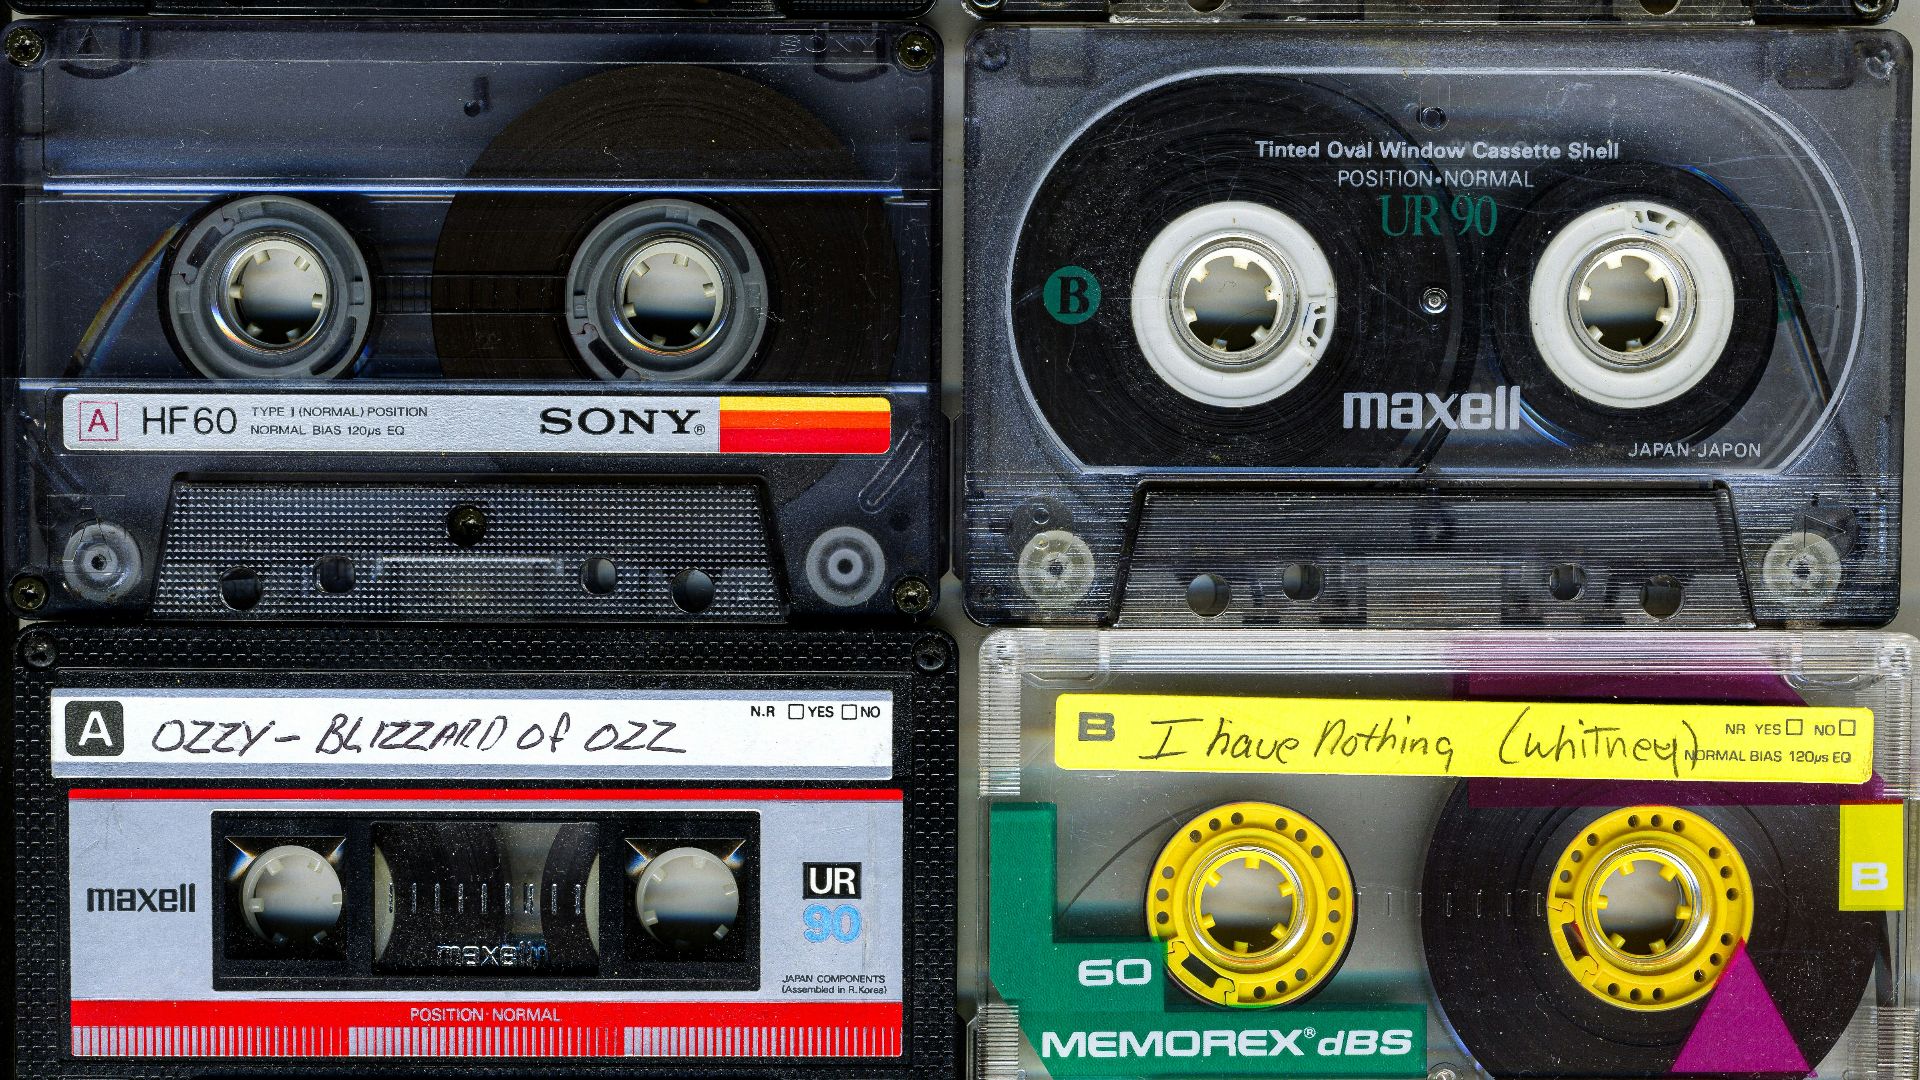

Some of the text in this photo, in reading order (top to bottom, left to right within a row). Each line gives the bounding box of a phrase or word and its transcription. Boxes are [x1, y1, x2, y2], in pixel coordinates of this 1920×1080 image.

[1255, 140, 1620, 159] Tinted Oval Window Cassette Shell
[1380, 194, 1498, 236] UR 90
[1057, 276, 1090, 314] B
[87, 408, 110, 432] A
[252, 406, 285, 417] TYPE
[299, 406, 364, 418] (NORMAL)
[367, 406, 428, 417] POSITION
[1343, 385, 1520, 430] maxell
[250, 425, 306, 435] NORMAL
[312, 425, 341, 435] BIAS
[387, 425, 405, 436] EQ
[807, 705, 835, 718] YES
[860, 705, 881, 718] NO
[78, 710, 114, 748] A
[316, 713, 508, 754] BLIZZARD
[583, 719, 687, 754] OZZ
[1078, 711, 1116, 742] B
[1138, 717, 1204, 760] I
[1206, 716, 1299, 764] have
[1726, 723, 1836, 736] NR YES NO
[1684, 749, 1746, 762] NORMAL
[1749, 750, 1782, 763] BIAS
[1832, 752, 1852, 764] EQ
[809, 867, 856, 895] UR
[1852, 862, 1888, 891] B
[87, 883, 196, 912] maxell
[803, 903, 862, 944] 90
[782, 974, 886, 984] JAPAN COMPONENTS
[1078, 959, 1152, 987] 60
[781, 984, 835, 995] (Assembled
[837, 984, 846, 994] in
[1317, 1029, 1413, 1055] dBS
